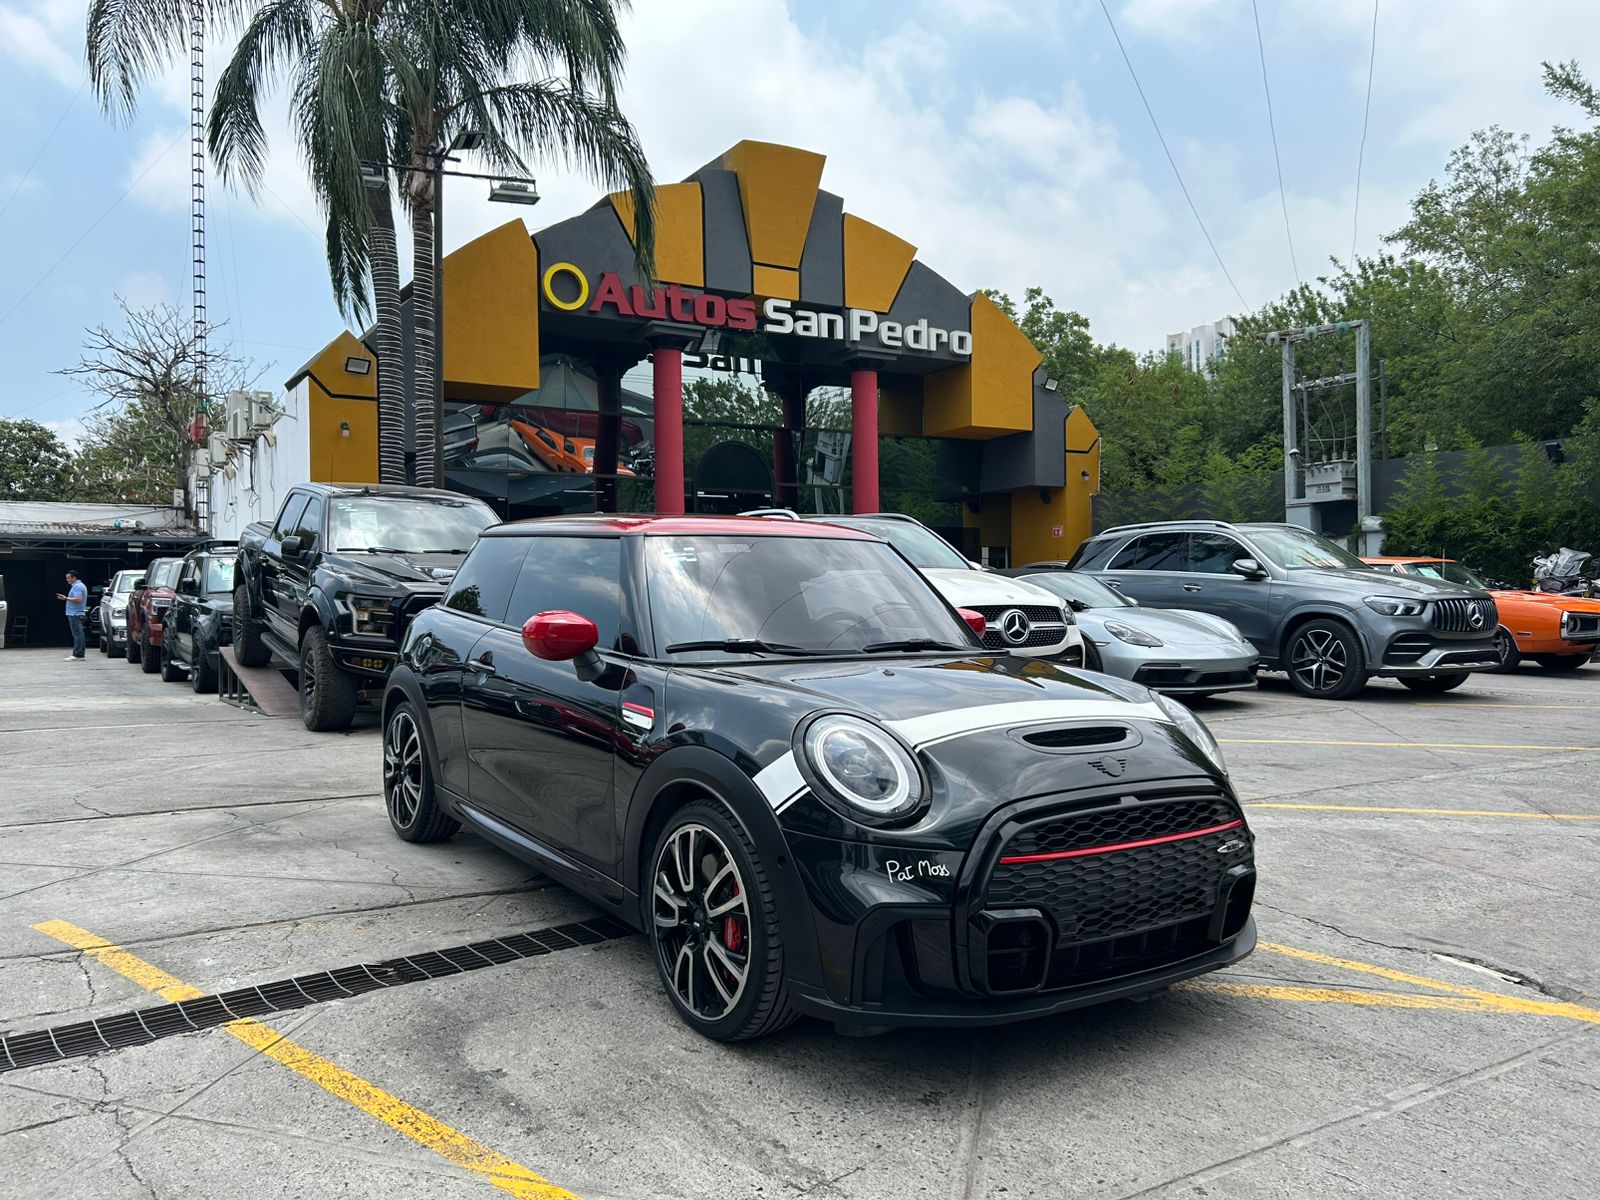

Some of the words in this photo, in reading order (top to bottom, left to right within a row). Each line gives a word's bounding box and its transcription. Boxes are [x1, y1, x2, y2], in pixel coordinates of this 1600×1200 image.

[589, 271, 757, 330] Autos
[763, 298, 844, 340] San
[849, 308, 973, 355] Pedro
